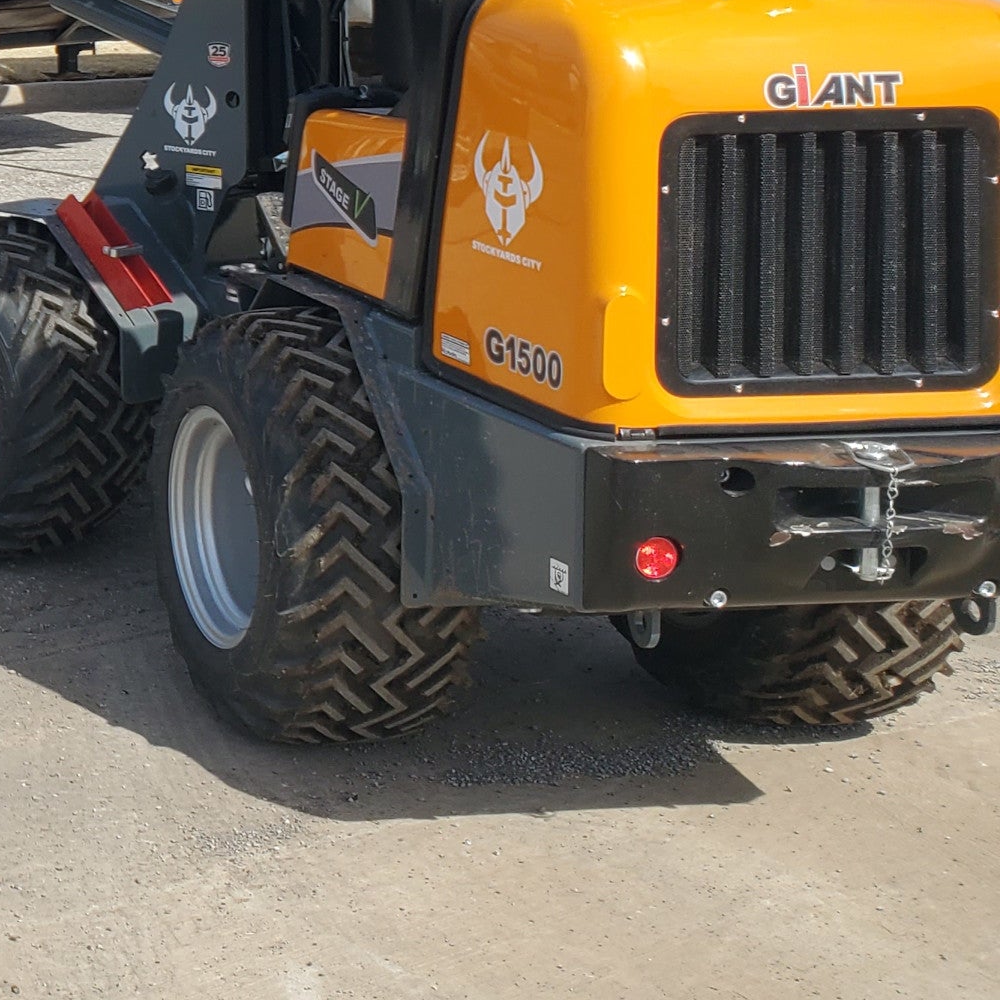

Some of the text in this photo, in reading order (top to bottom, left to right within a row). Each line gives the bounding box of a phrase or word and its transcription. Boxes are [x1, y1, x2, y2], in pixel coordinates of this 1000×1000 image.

[211, 45, 226, 57] 25
[164, 144, 216, 157] STOCKYARDS CITY
[320, 168, 371, 219] STAGE V
[472, 239, 542, 272] STOCKYARDS CITY
[484, 326, 562, 390] G1500
